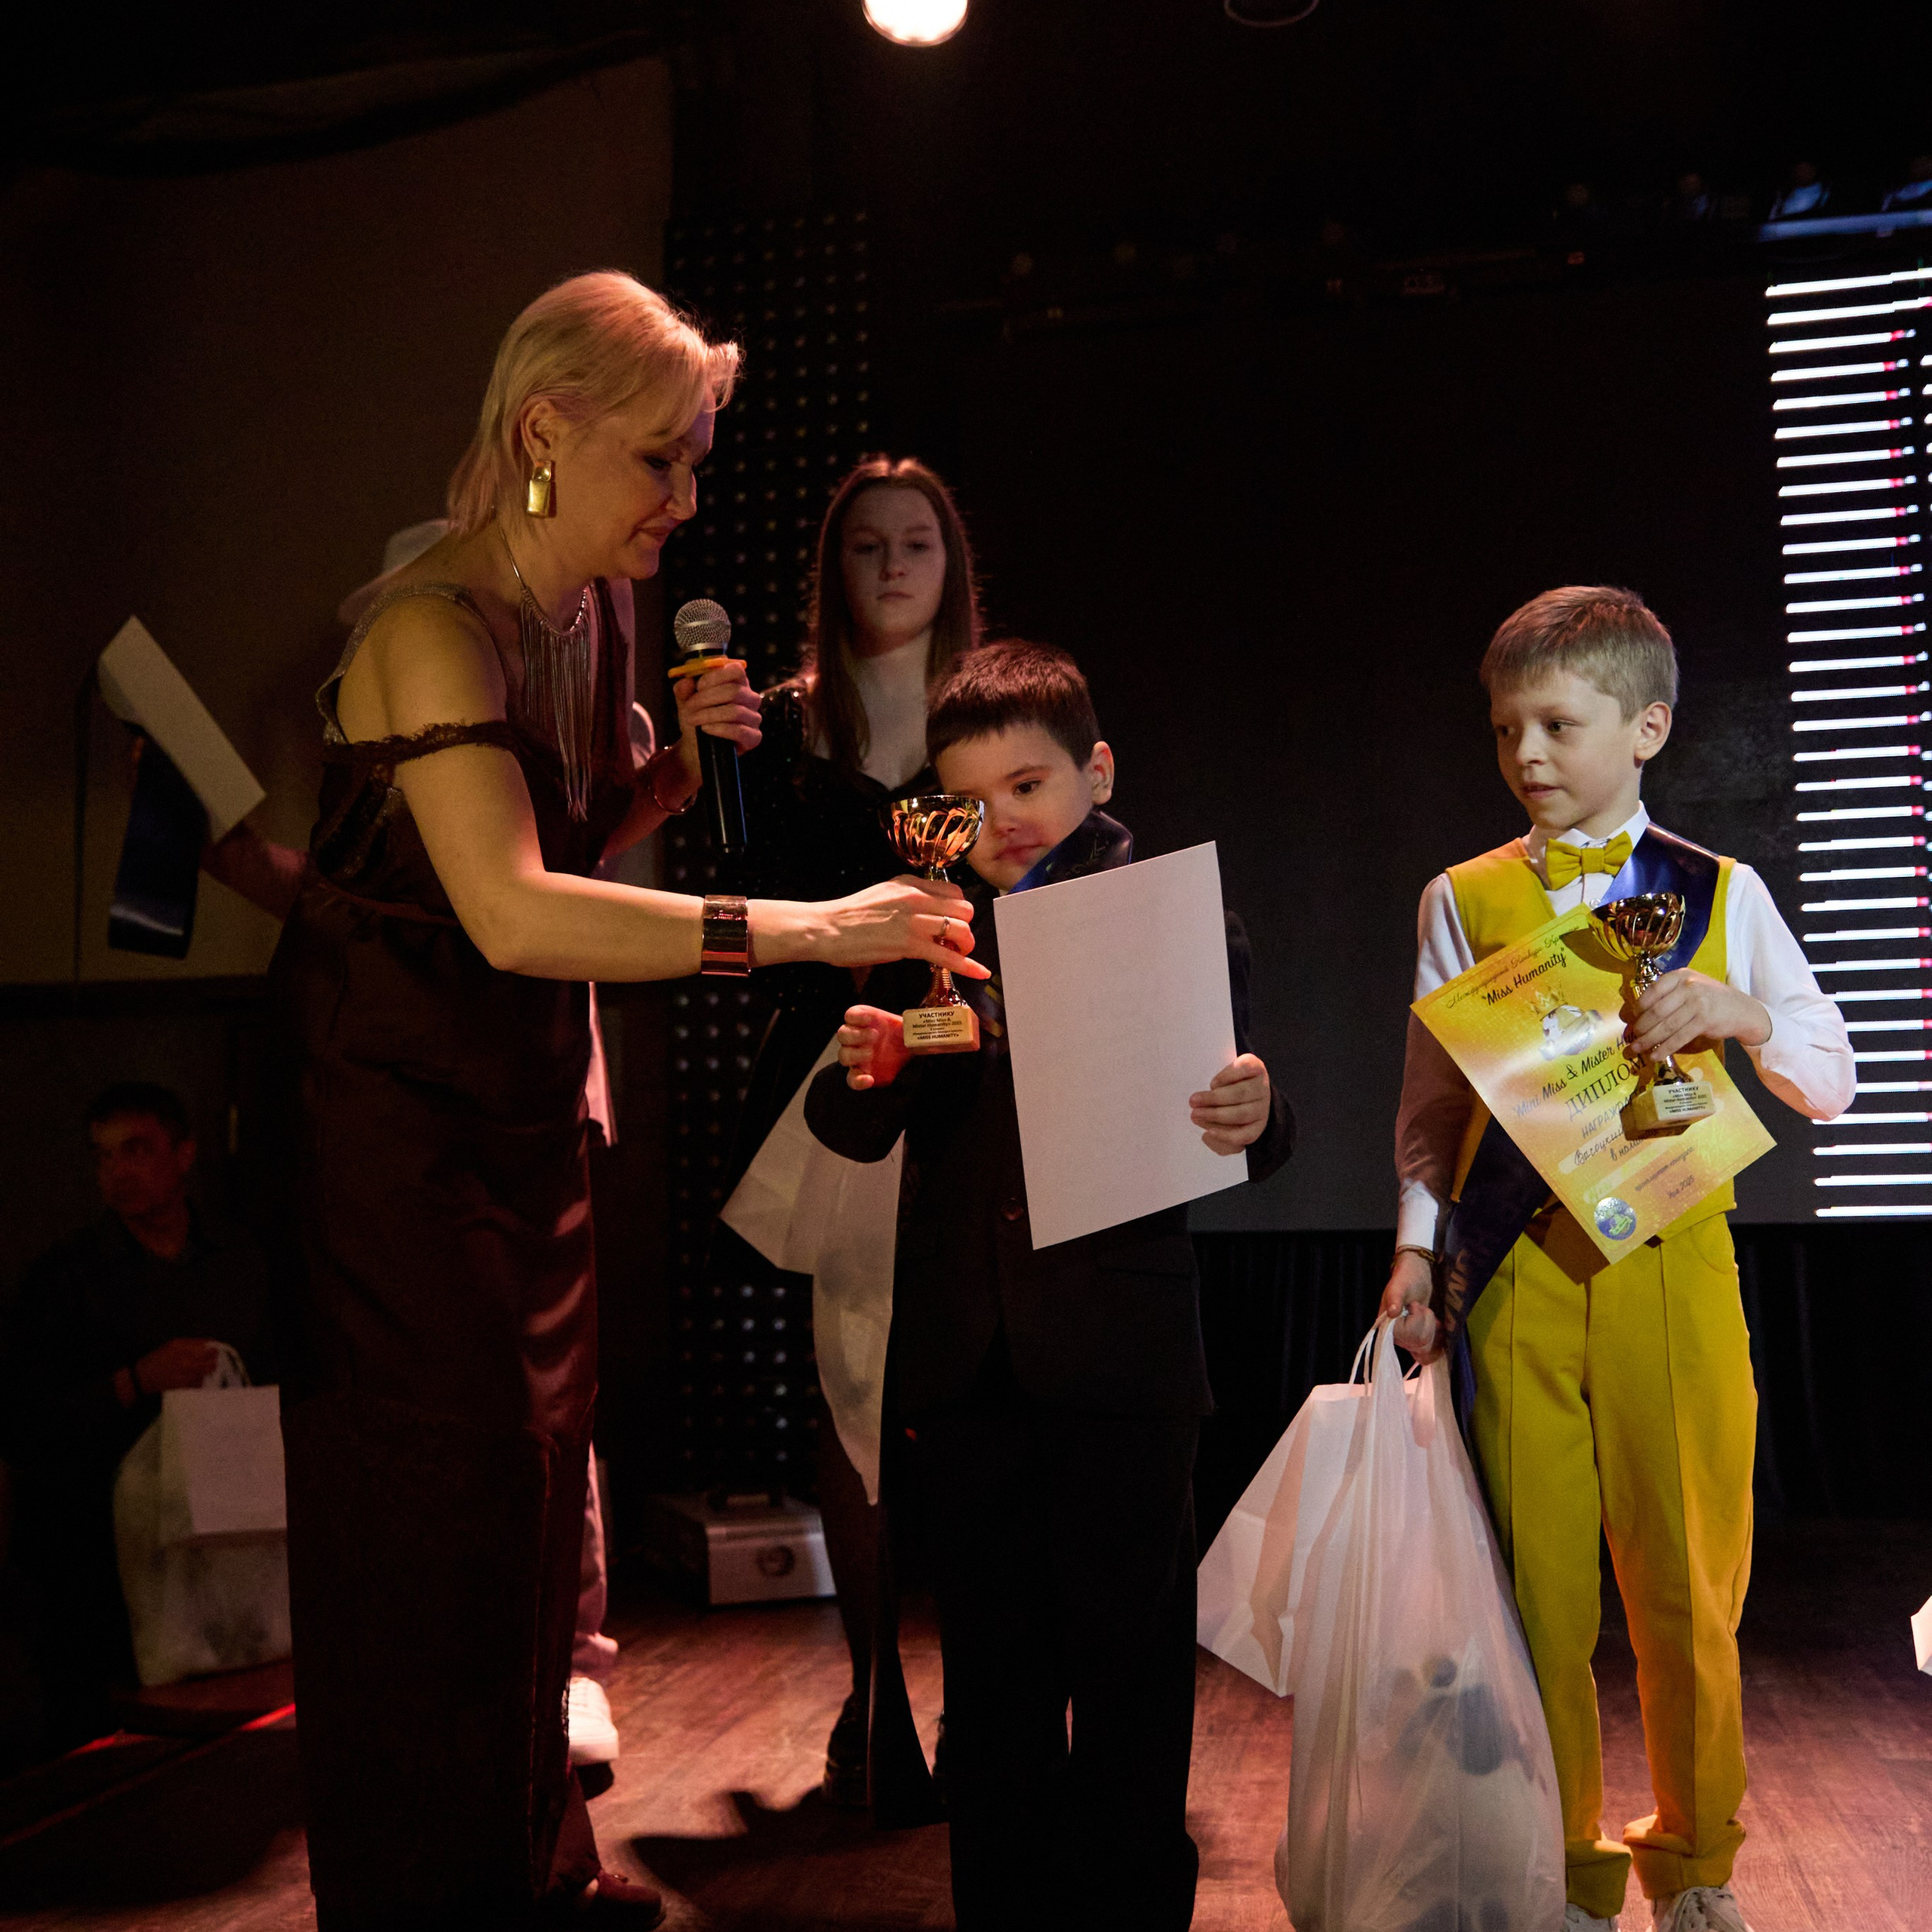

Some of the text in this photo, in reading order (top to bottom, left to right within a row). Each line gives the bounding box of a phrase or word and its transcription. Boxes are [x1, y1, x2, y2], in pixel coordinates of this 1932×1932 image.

[1542, 1078, 1567, 1100] Miss
[1566, 1063, 1578, 1080] &
[1580, 1046, 1615, 1075] Mister
[1564, 1054, 1647, 1122] ДИПЛОМ
[1609, 1148, 1618, 1161] в
